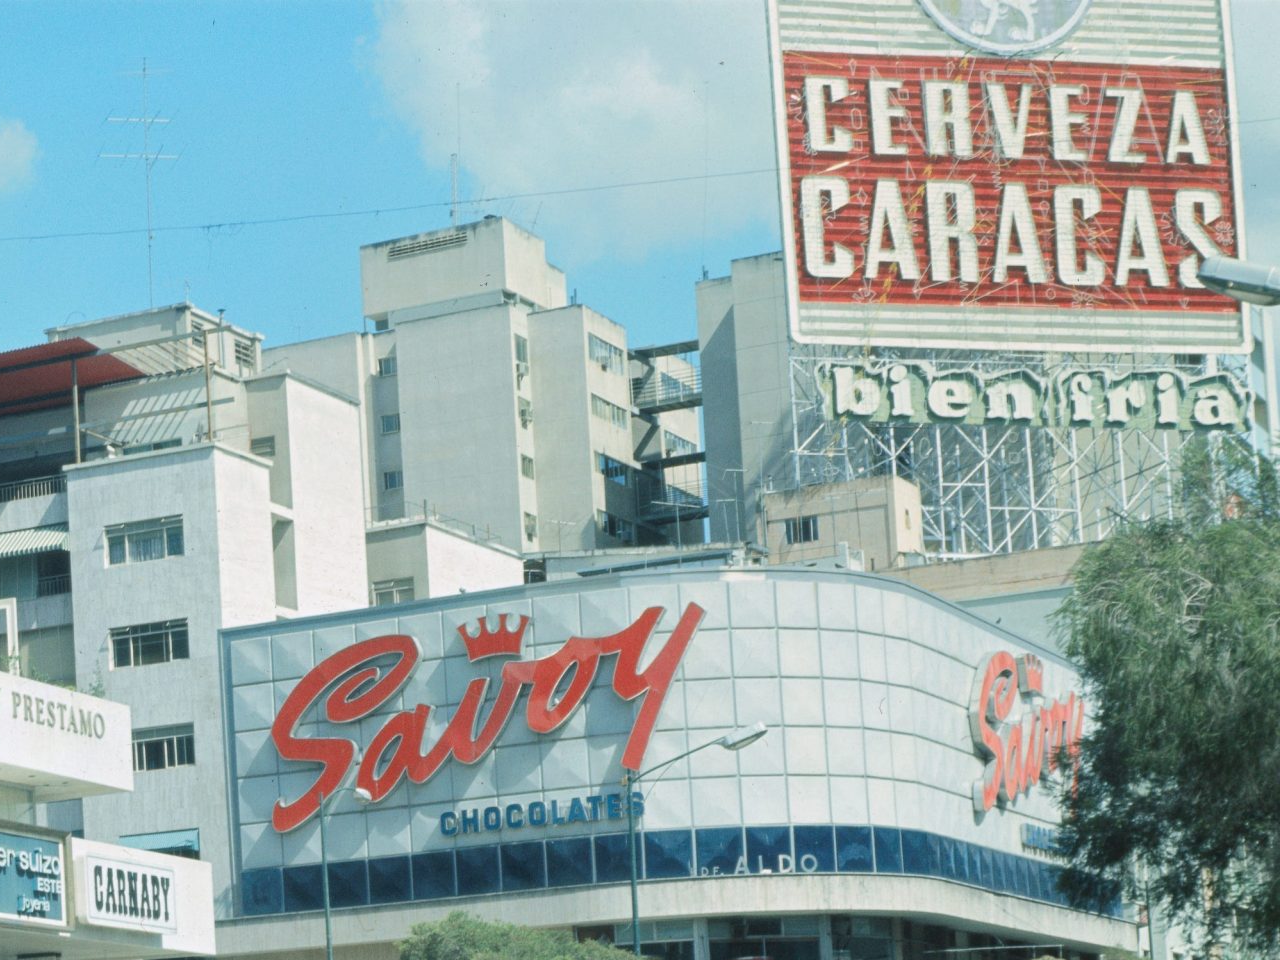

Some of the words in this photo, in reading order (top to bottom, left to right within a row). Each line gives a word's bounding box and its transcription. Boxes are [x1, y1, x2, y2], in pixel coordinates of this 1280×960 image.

[803, 75, 1211, 166] CERVEZA
[800, 175, 1229, 289] CARACAS
[832, 365, 1036, 421] bien
[1070, 372, 1239, 426] fria
[11, 690, 106, 740] PRESTAMO
[270, 601, 707, 833] Savoy
[439, 790, 646, 837] CHOCOLATES
[19, 847, 62, 876] suizo
[36, 876, 62, 894] ESTE
[734, 852, 819, 875] ALDO
[93, 864, 171, 922] CARNABY
